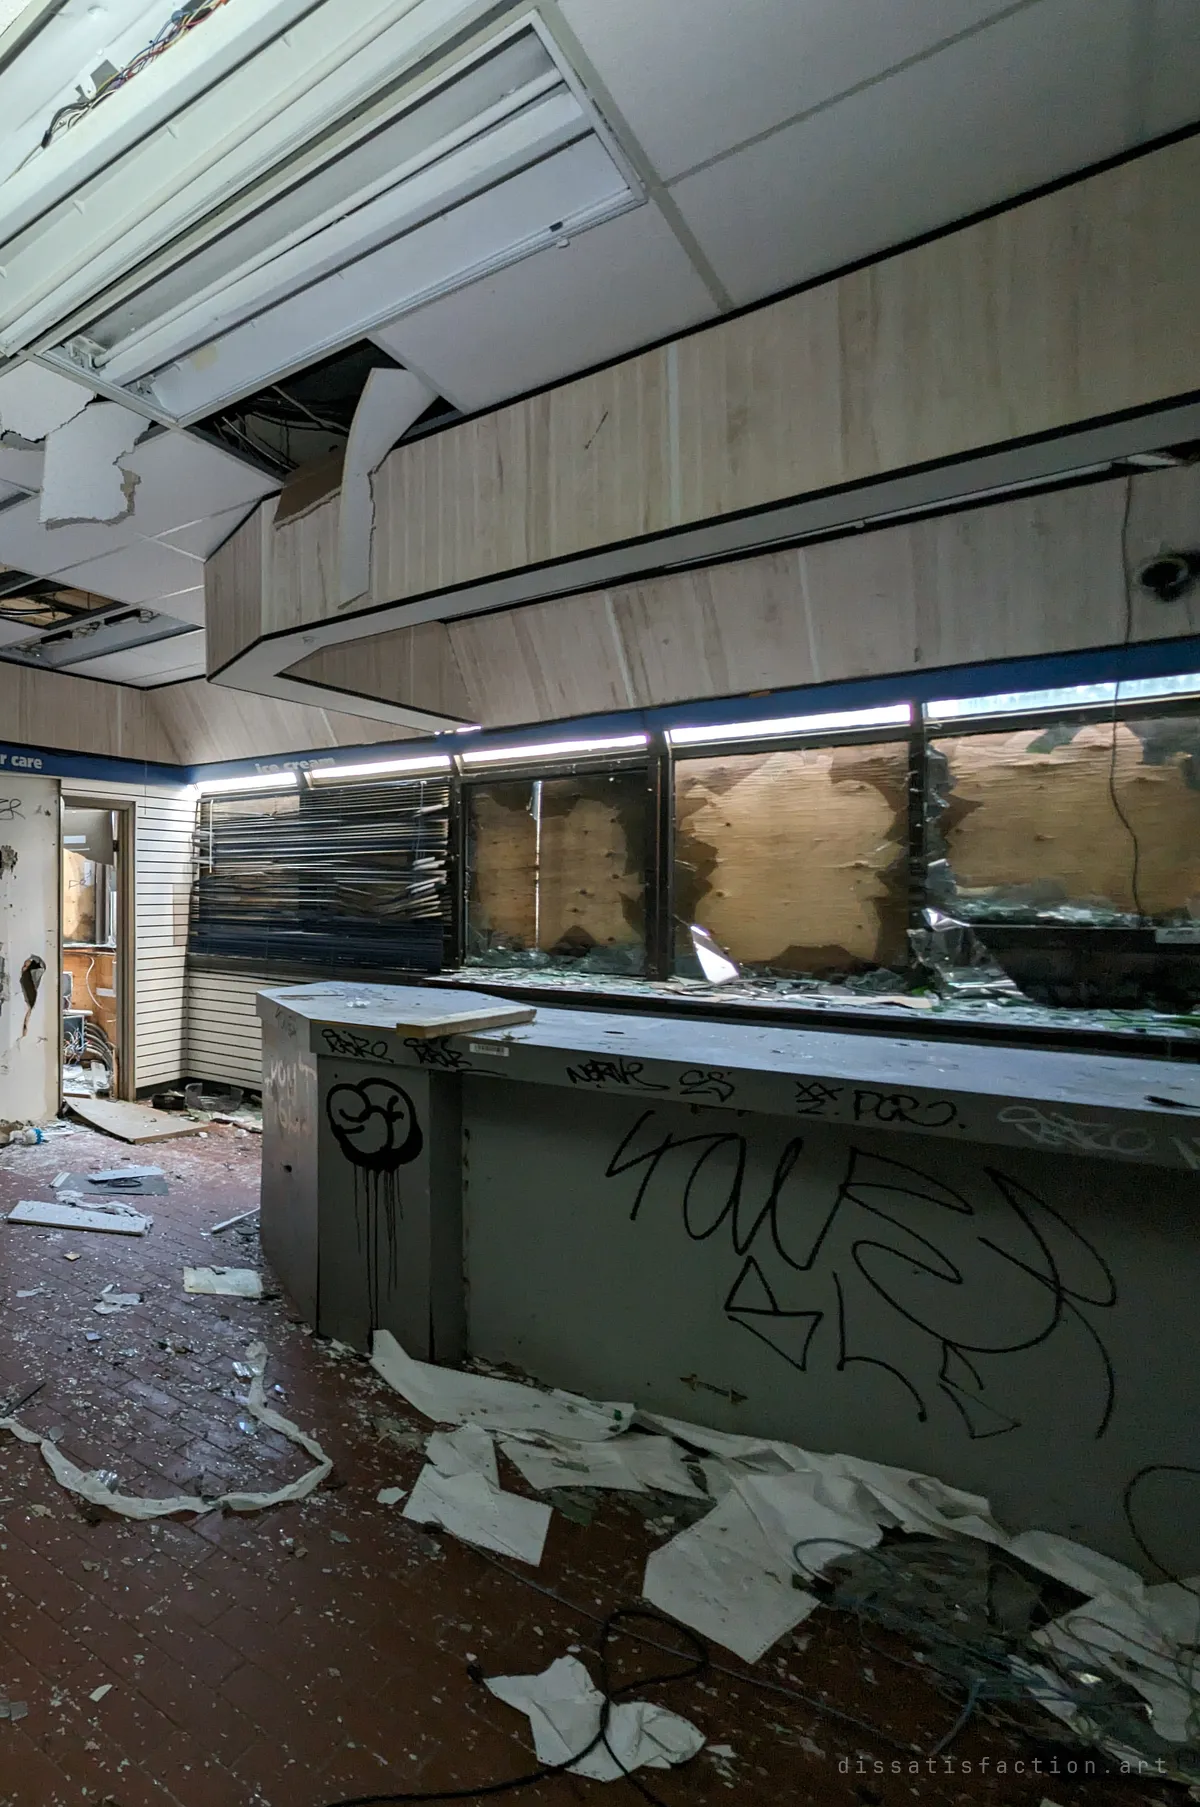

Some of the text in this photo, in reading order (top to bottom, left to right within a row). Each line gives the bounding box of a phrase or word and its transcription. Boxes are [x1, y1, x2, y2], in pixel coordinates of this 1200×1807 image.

[11, 754, 44, 771] care
[254, 756, 336, 776] ice cream
